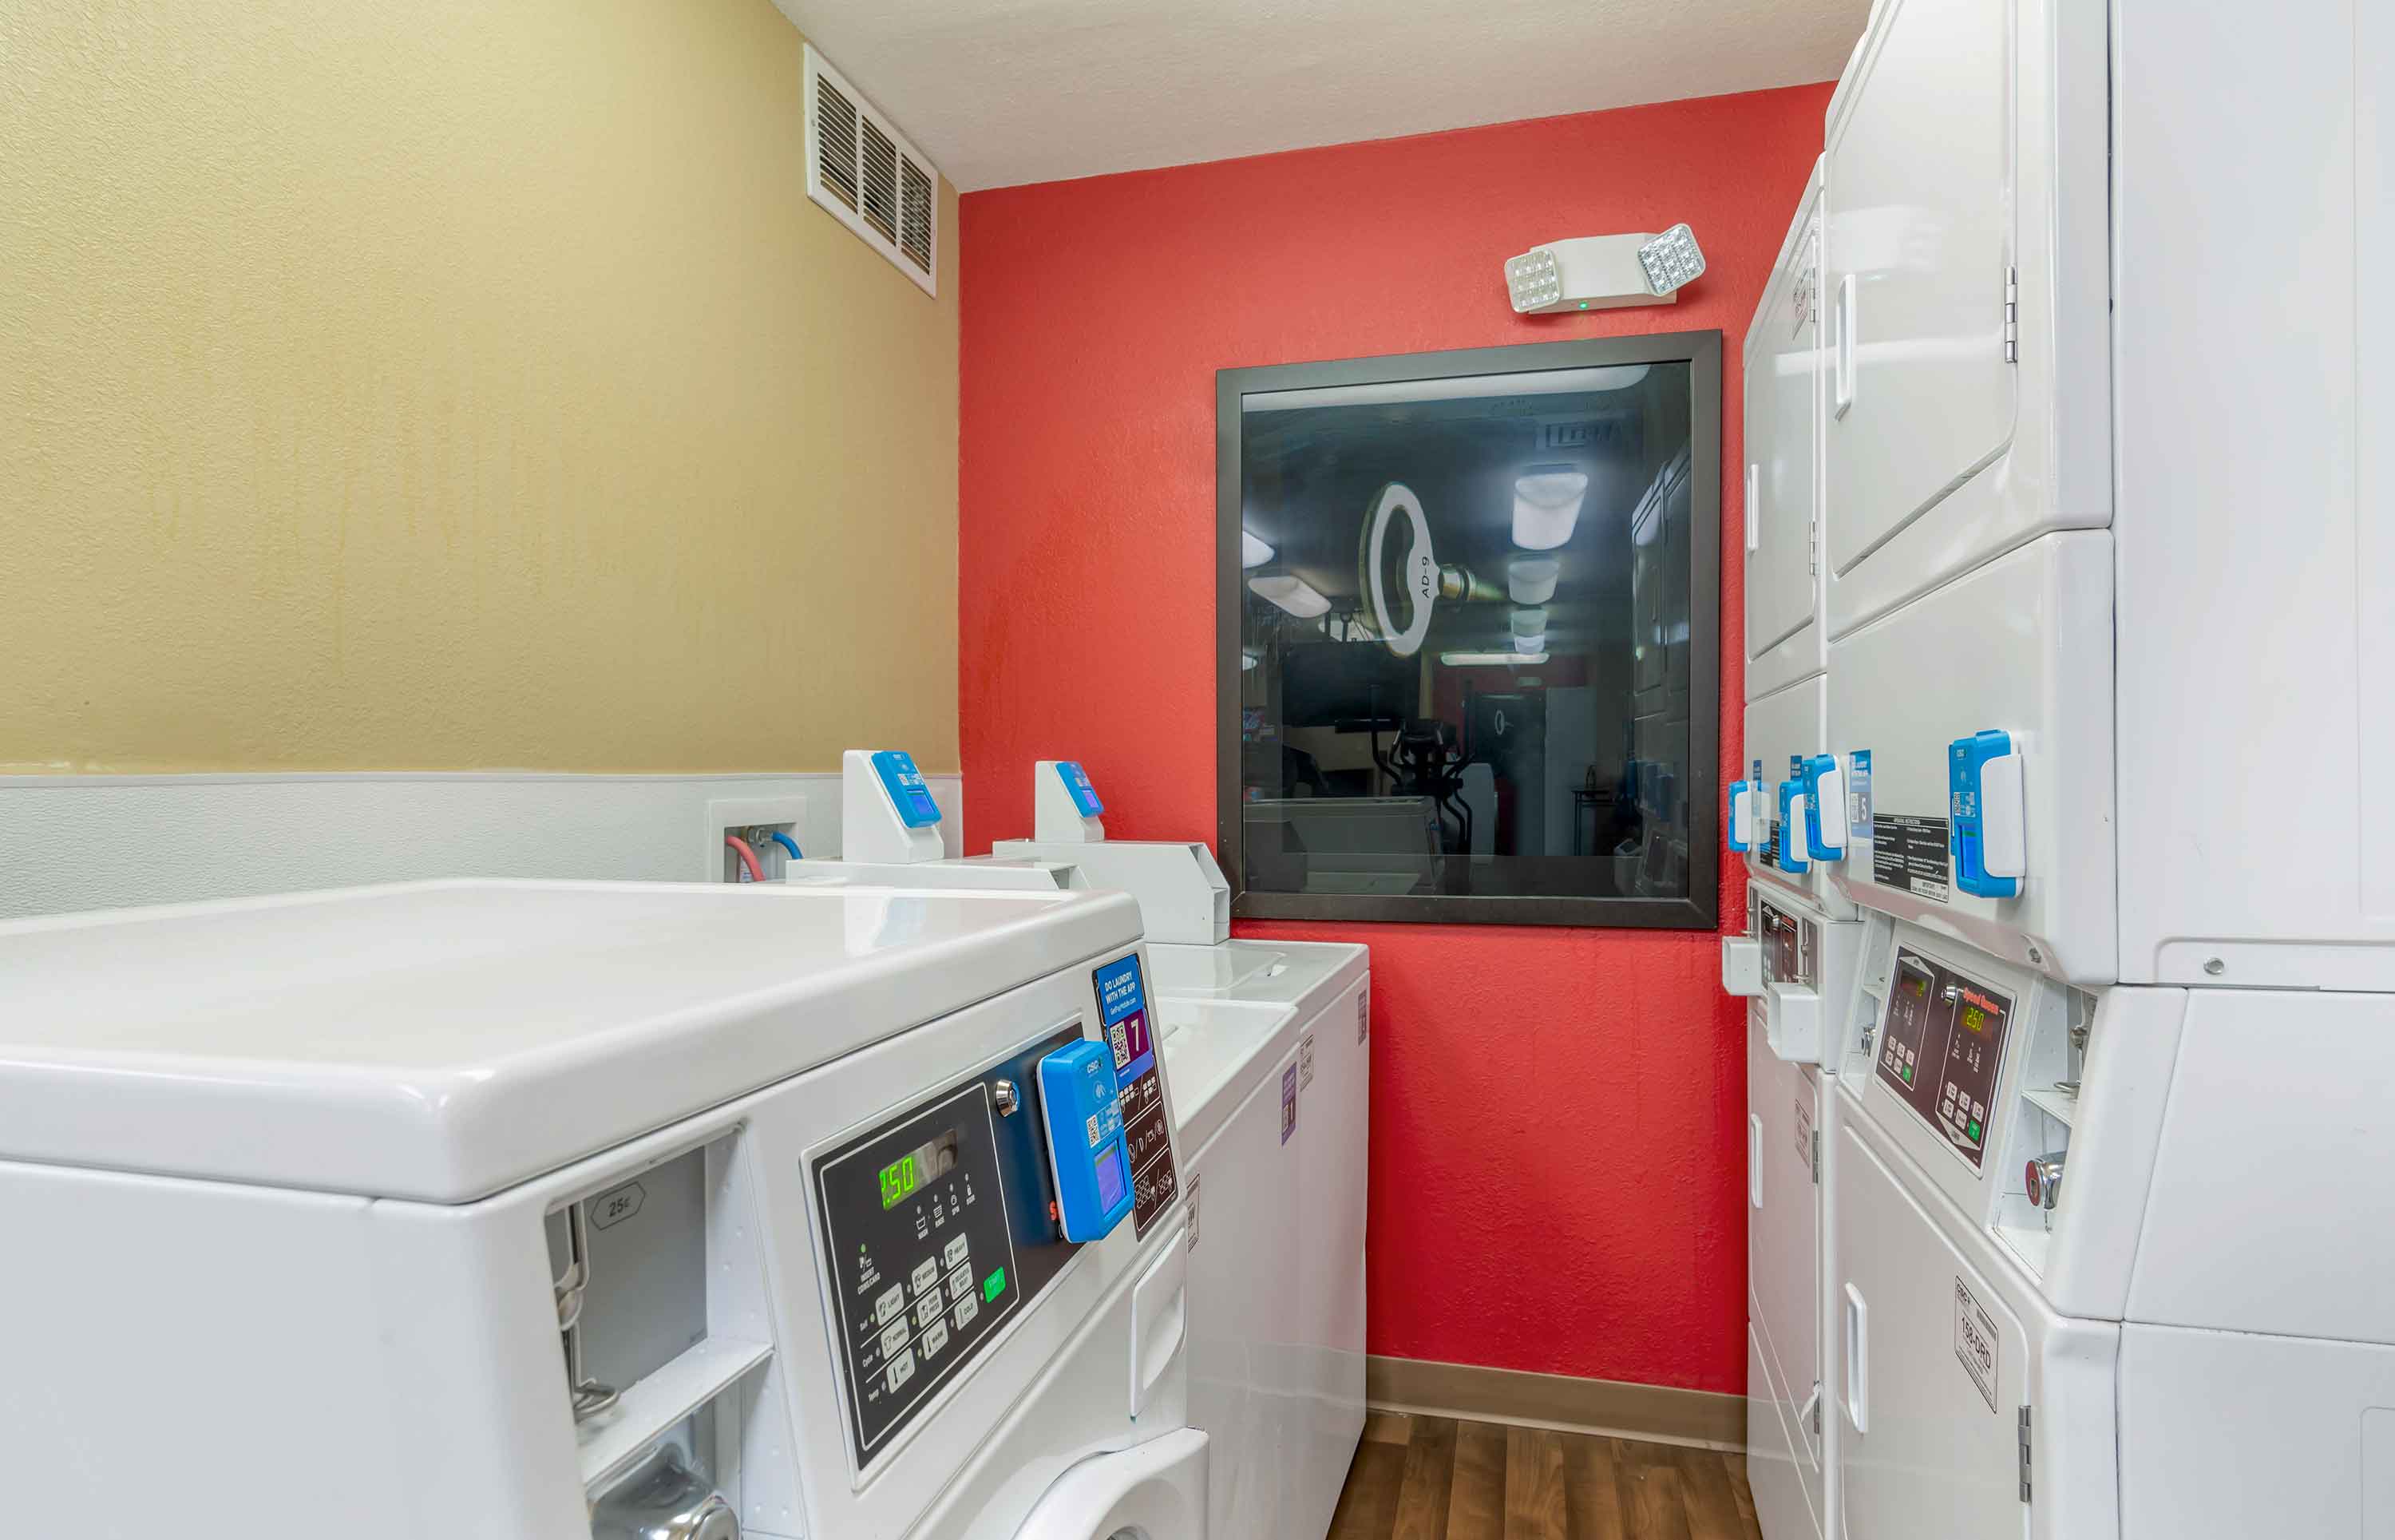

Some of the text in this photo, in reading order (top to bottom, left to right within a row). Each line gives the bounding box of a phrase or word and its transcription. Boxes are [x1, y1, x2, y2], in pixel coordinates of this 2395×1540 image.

[1861, 798, 1867, 821] 5
[1105, 971, 1132, 992] DO LAUNDRY
[1106, 982, 1136, 1004] WITH THE APP
[1130, 1018, 1139, 1051] 7
[1962, 1316, 1992, 1369] 158-DRD
